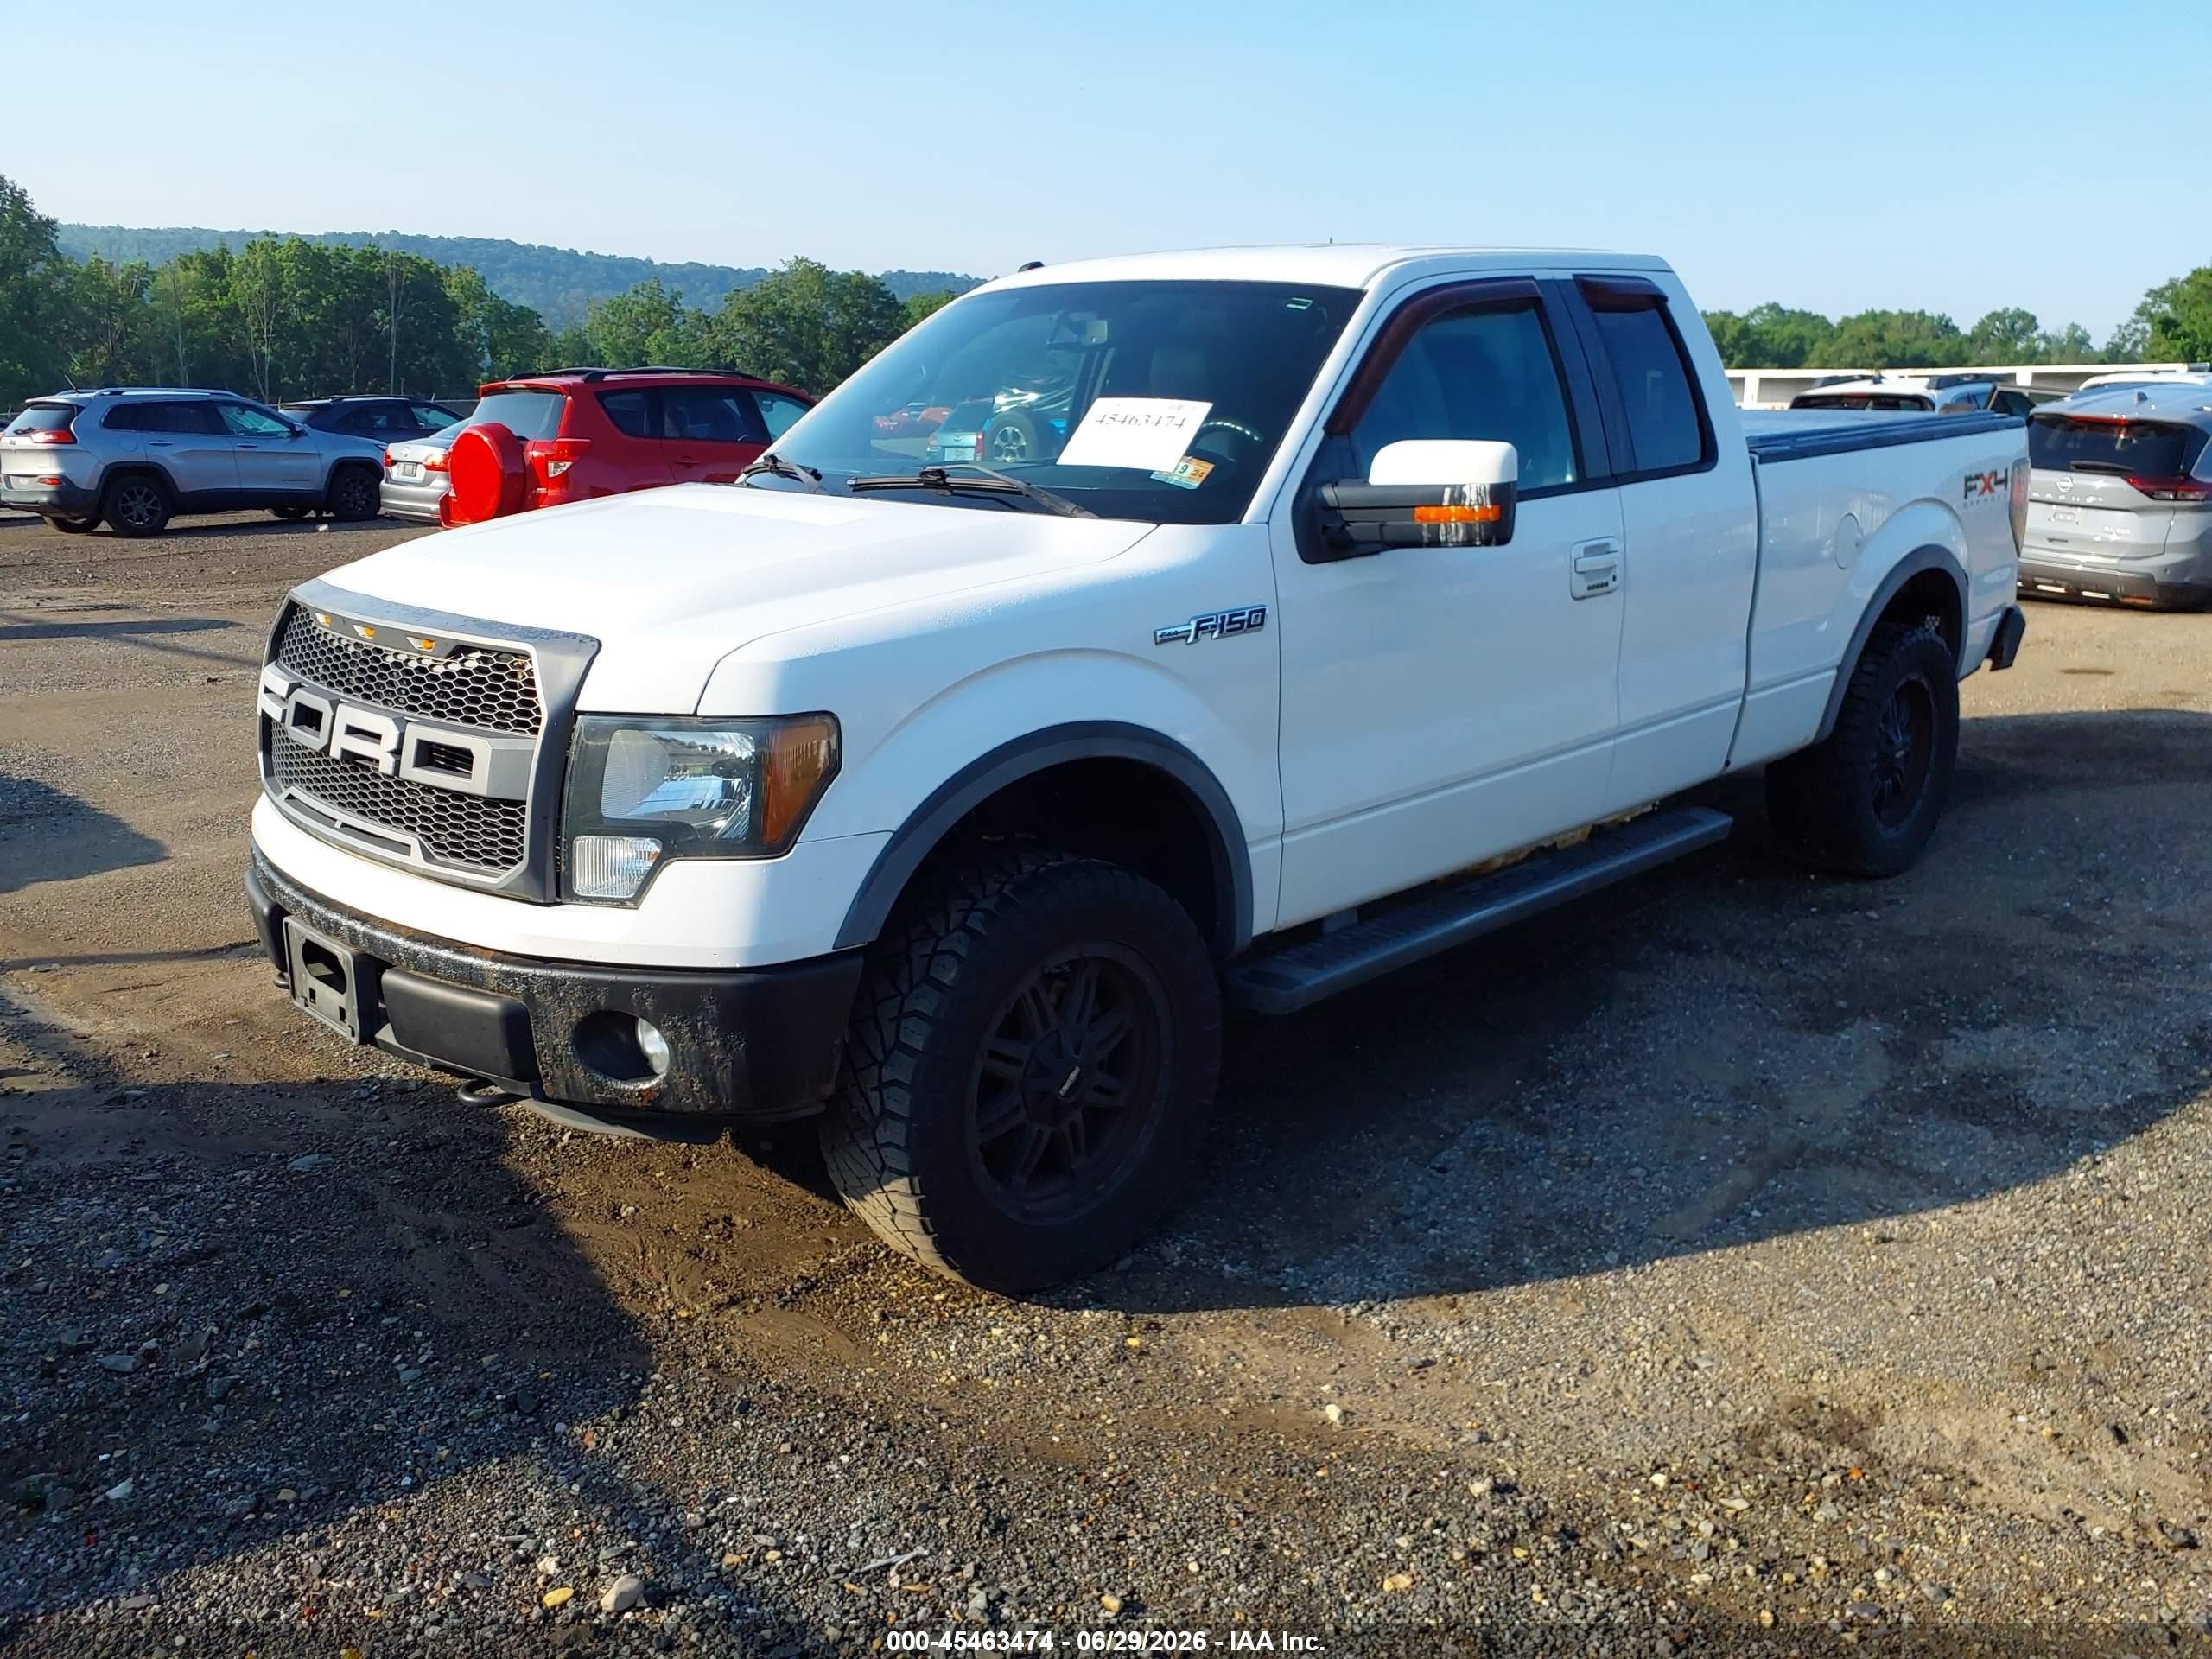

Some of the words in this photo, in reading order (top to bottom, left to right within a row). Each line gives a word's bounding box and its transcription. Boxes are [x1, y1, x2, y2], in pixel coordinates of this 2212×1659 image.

[1095, 413, 1186, 429] 45463474
[1178, 463, 1190, 474] 9
[1963, 467, 2009, 499] FX4
[259, 661, 493, 796] FORD
